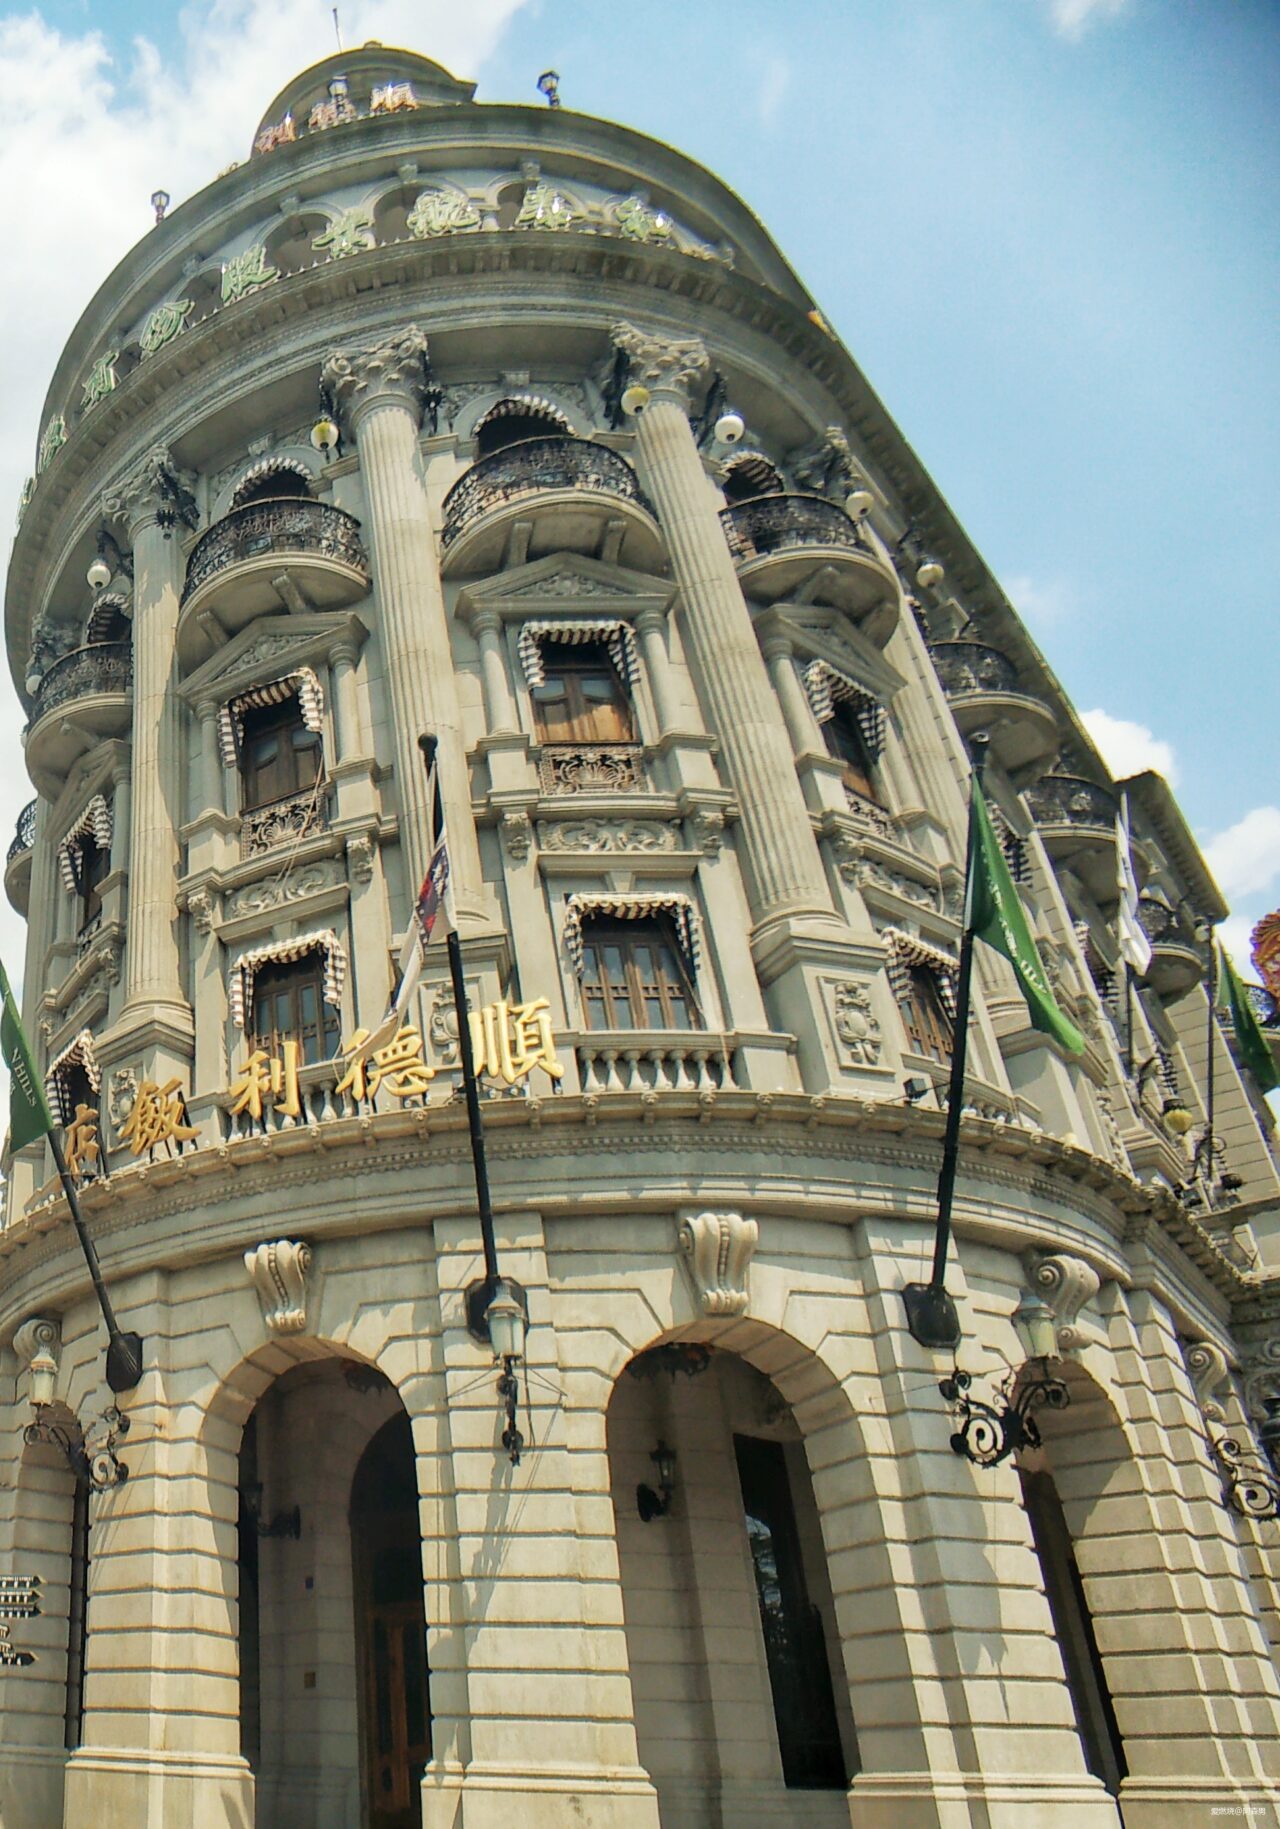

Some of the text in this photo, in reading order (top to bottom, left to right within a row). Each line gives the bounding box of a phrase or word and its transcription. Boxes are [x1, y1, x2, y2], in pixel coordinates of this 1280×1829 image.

[14, 1062, 37, 1107] HILLS
[64, 996, 564, 1173] 順德利飯店
